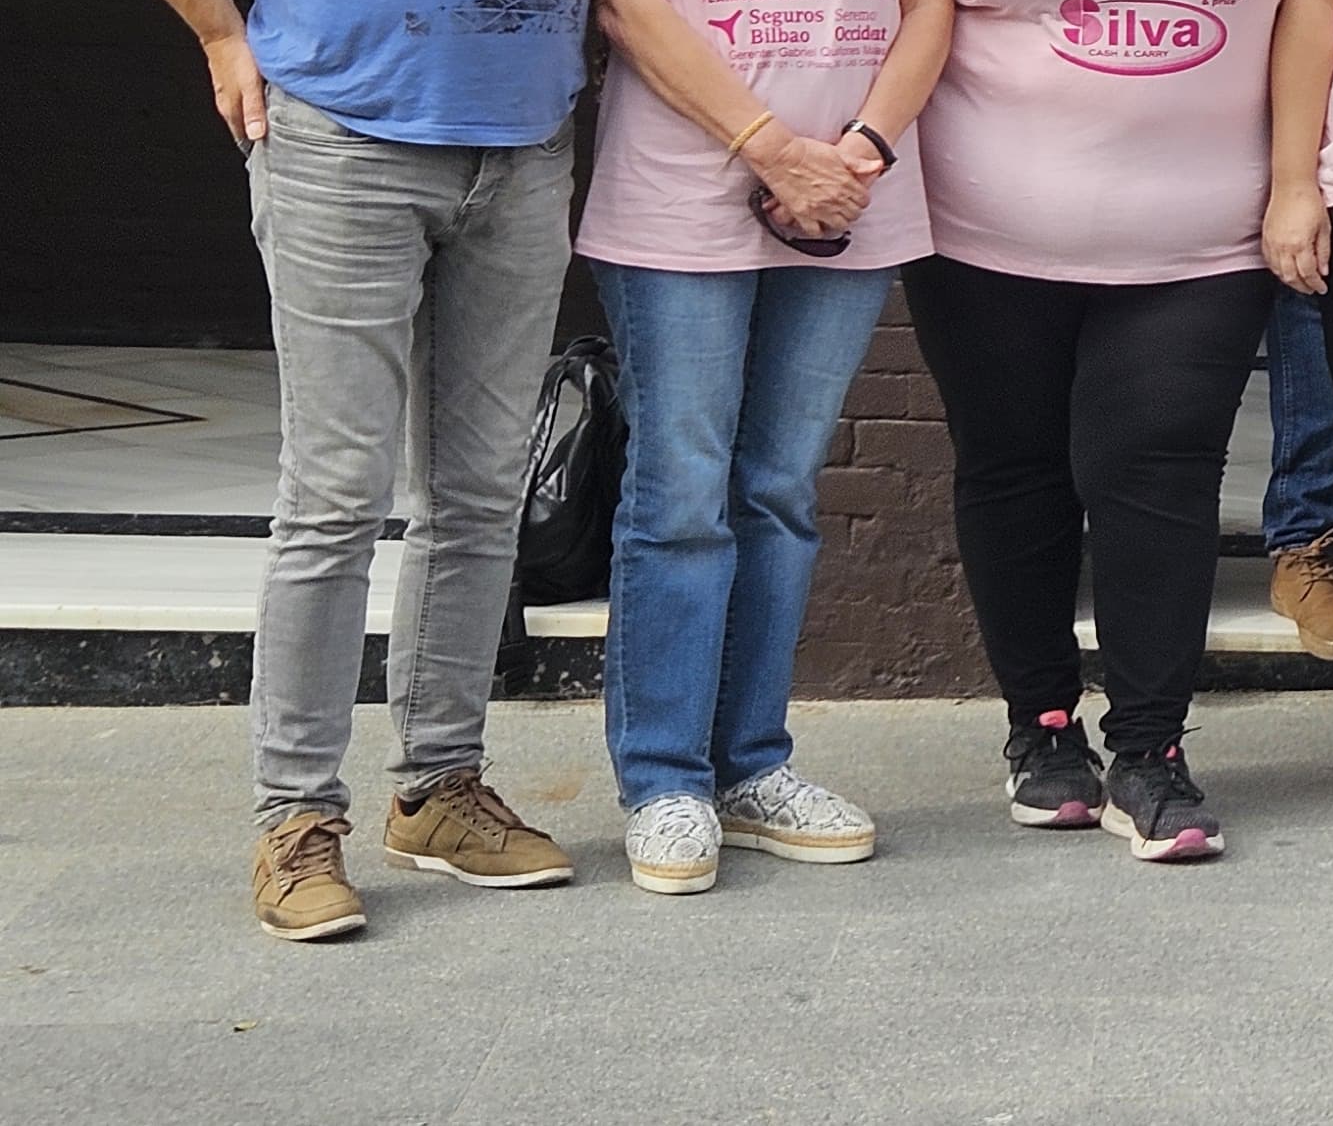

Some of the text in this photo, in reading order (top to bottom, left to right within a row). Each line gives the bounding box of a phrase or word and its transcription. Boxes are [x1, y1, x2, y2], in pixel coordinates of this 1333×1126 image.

[750, 9, 824, 27] Seguros
[751, 28, 810, 45] Bilbao
[1088, 49, 1118, 58] CASH
[1134, 49, 1169, 58] CARRY
